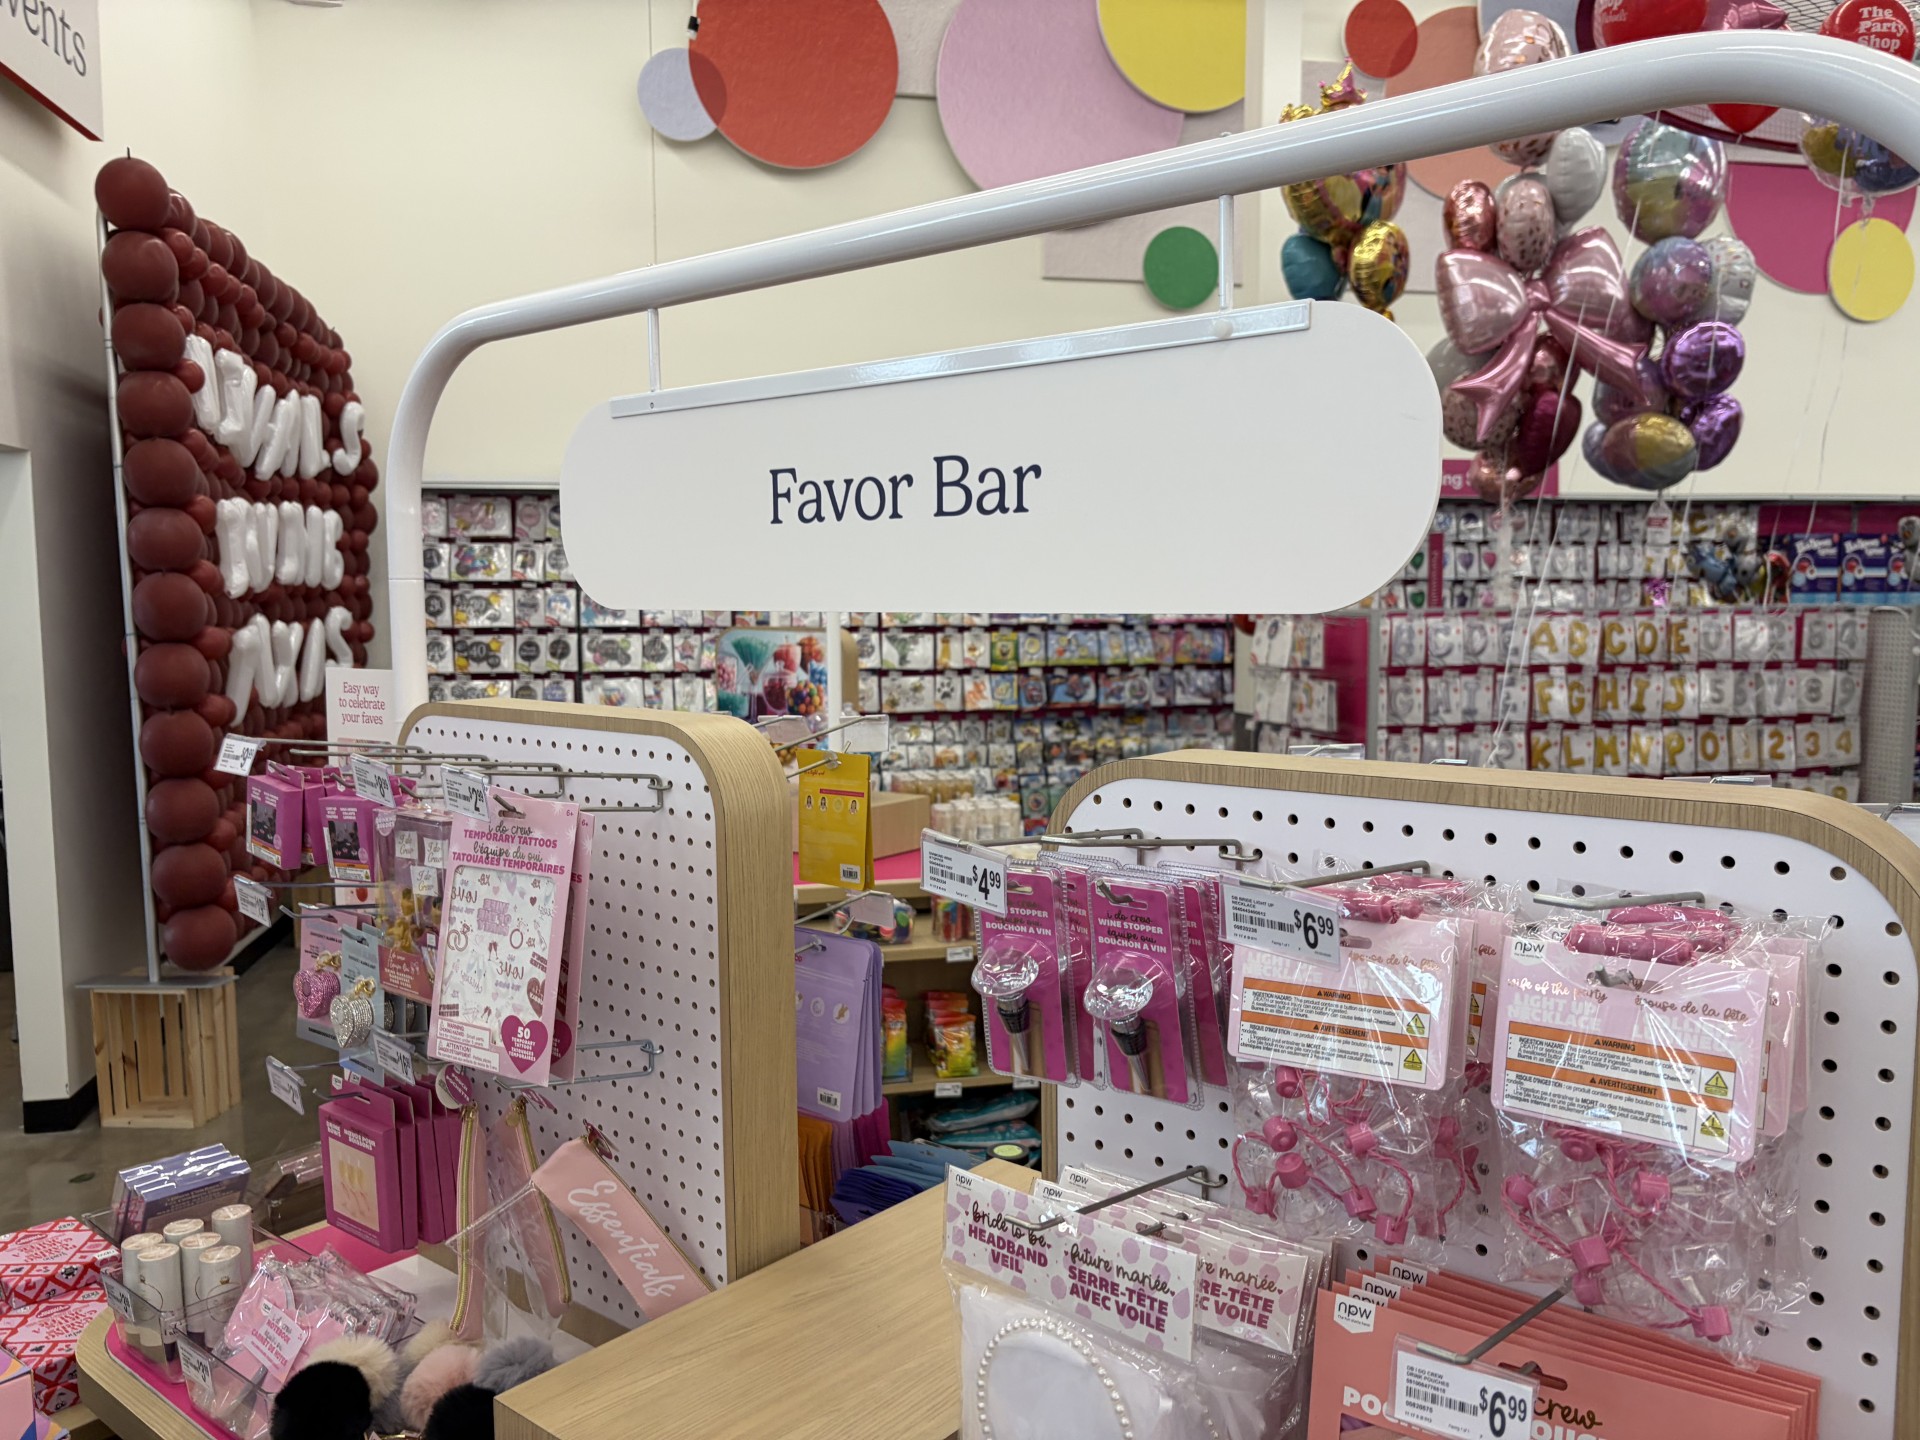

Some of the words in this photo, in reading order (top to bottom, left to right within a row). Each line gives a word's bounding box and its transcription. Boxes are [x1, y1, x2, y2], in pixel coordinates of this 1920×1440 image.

[1859, 6, 1893, 18] The
[1858, 20, 1904, 37] Party
[769, 467, 914, 525] Favor
[933, 455, 1042, 517] Bar
[343, 682, 361, 697] Easy
[363, 685, 379, 697] way
[339, 697, 347, 708] to
[348, 696, 385, 711] celebrate
[342, 713, 360, 725] your
[362, 711, 383, 725] faves
[464, 829, 516, 844] TEMPORARY
[518, 836, 557, 849] TATTOOS
[452, 852, 500, 866] TATOUAGES
[503, 858, 565, 875] TEMPORAIRES
[1010, 907, 1048, 918] STOPPER
[985, 921, 1027, 934] BOUCHON
[1036, 928, 1052, 936] VIN
[1098, 918, 1122, 928] WINE
[1123, 921, 1163, 935] STOPPER
[1098, 936, 1141, 949] BOUCHON
[1151, 945, 1167, 954] VIN
[1514, 940, 1544, 954] npw
[1324, 991, 1351, 1001] WARNING
[1681, 1001, 1698, 1015] de
[1701, 1004, 1720, 1017] la
[517, 1026, 531, 1039] 50
[1602, 1041, 1636, 1052] WARNING
[1599, 1079, 1657, 1095] AVERTISSEMENT
[955, 1173, 973, 1187] npw
[1069, 1172, 1089, 1185] npw
[1042, 1186, 1063, 1199] npw
[972, 1200, 1009, 1232] bride
[568, 1180, 685, 1297] Essentials
[968, 1224, 1048, 1267] HEADBAND
[991, 1249, 1024, 1274] VEIL
[1070, 1243, 1112, 1273] future
[1116, 1265, 1171, 1294] mariée
[1219, 1267, 1277, 1293] mariée
[1393, 1266, 1424, 1284] npw
[1068, 1265, 1169, 1317] SERRE-TÊTE
[1364, 1282, 1397, 1299] npw
[1069, 1283, 1111, 1311] AVEC
[1115, 1300, 1166, 1333] VOILE
[1213, 1300, 1270, 1330] VOILE
[1338, 1301, 1372, 1320] npw
[1427, 1370, 1444, 1380] CREW
[1534, 1397, 1603, 1430] crew
